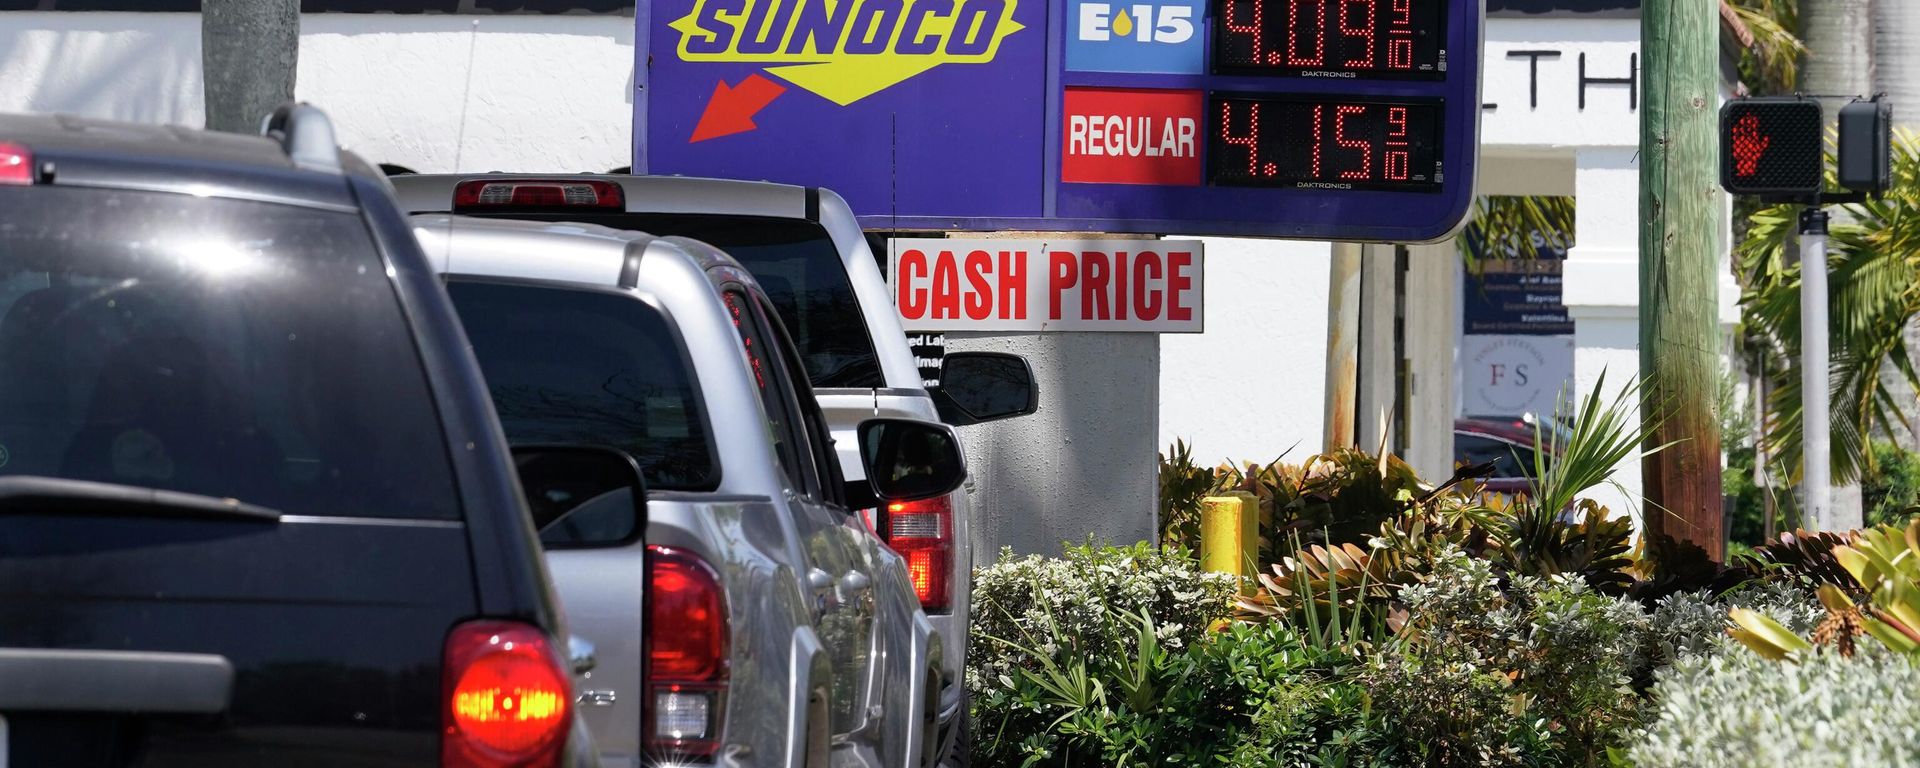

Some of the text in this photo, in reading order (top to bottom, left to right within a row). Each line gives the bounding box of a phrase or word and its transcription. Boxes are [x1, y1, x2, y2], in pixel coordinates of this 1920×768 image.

[685, 0, 1006, 54] SUNOCO
[1226, 0, 1376, 68] 4.09
[1301, 70, 1357, 79] DAKTRONICS
[1070, 115, 1196, 158] REGULAR
[1222, 102, 1371, 179] 4.15
[1297, 181, 1353, 190] DAKTRONICS
[899, 249, 1192, 321] CASH PRICE
